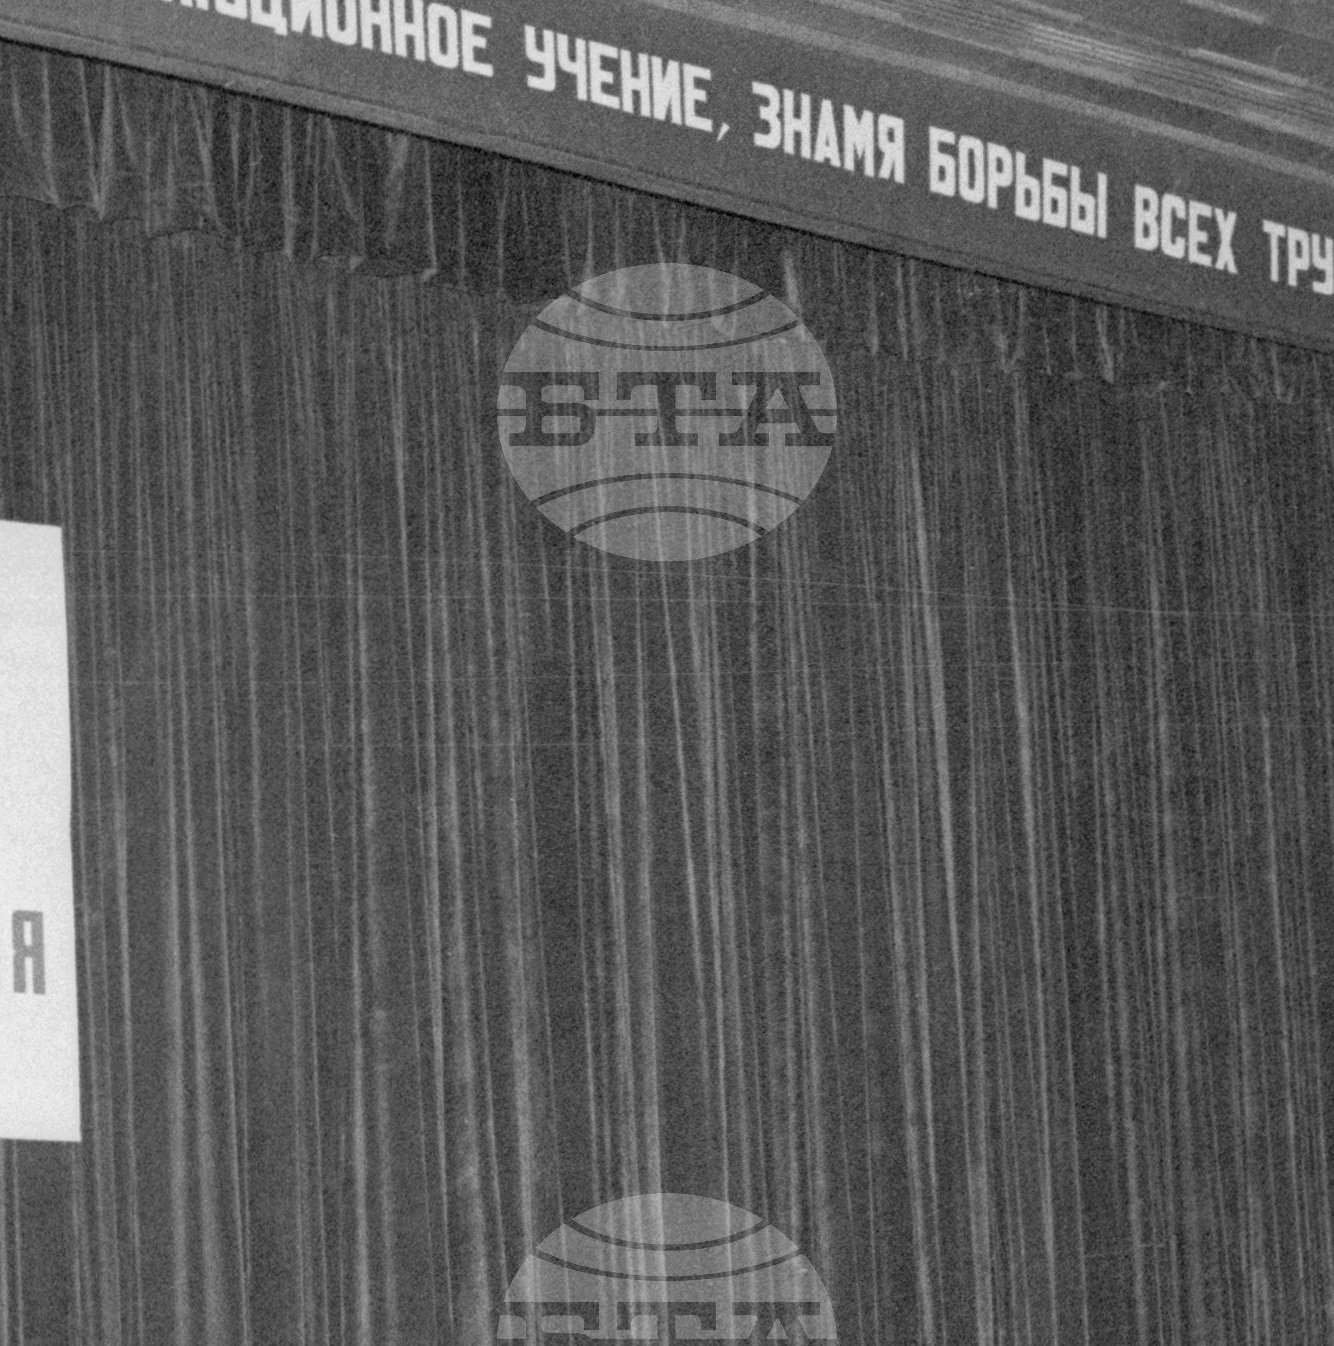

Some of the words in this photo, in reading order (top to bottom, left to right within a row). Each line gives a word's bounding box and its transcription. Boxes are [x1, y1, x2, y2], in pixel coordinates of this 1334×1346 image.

[524, 24, 730, 140] УЧЕНИЕ,
[751, 81, 905, 184] ЗНАМЯ
[928, 126, 1107, 238] БОРЬБЫ
[1134, 185, 1237, 273] ВСЕХ
